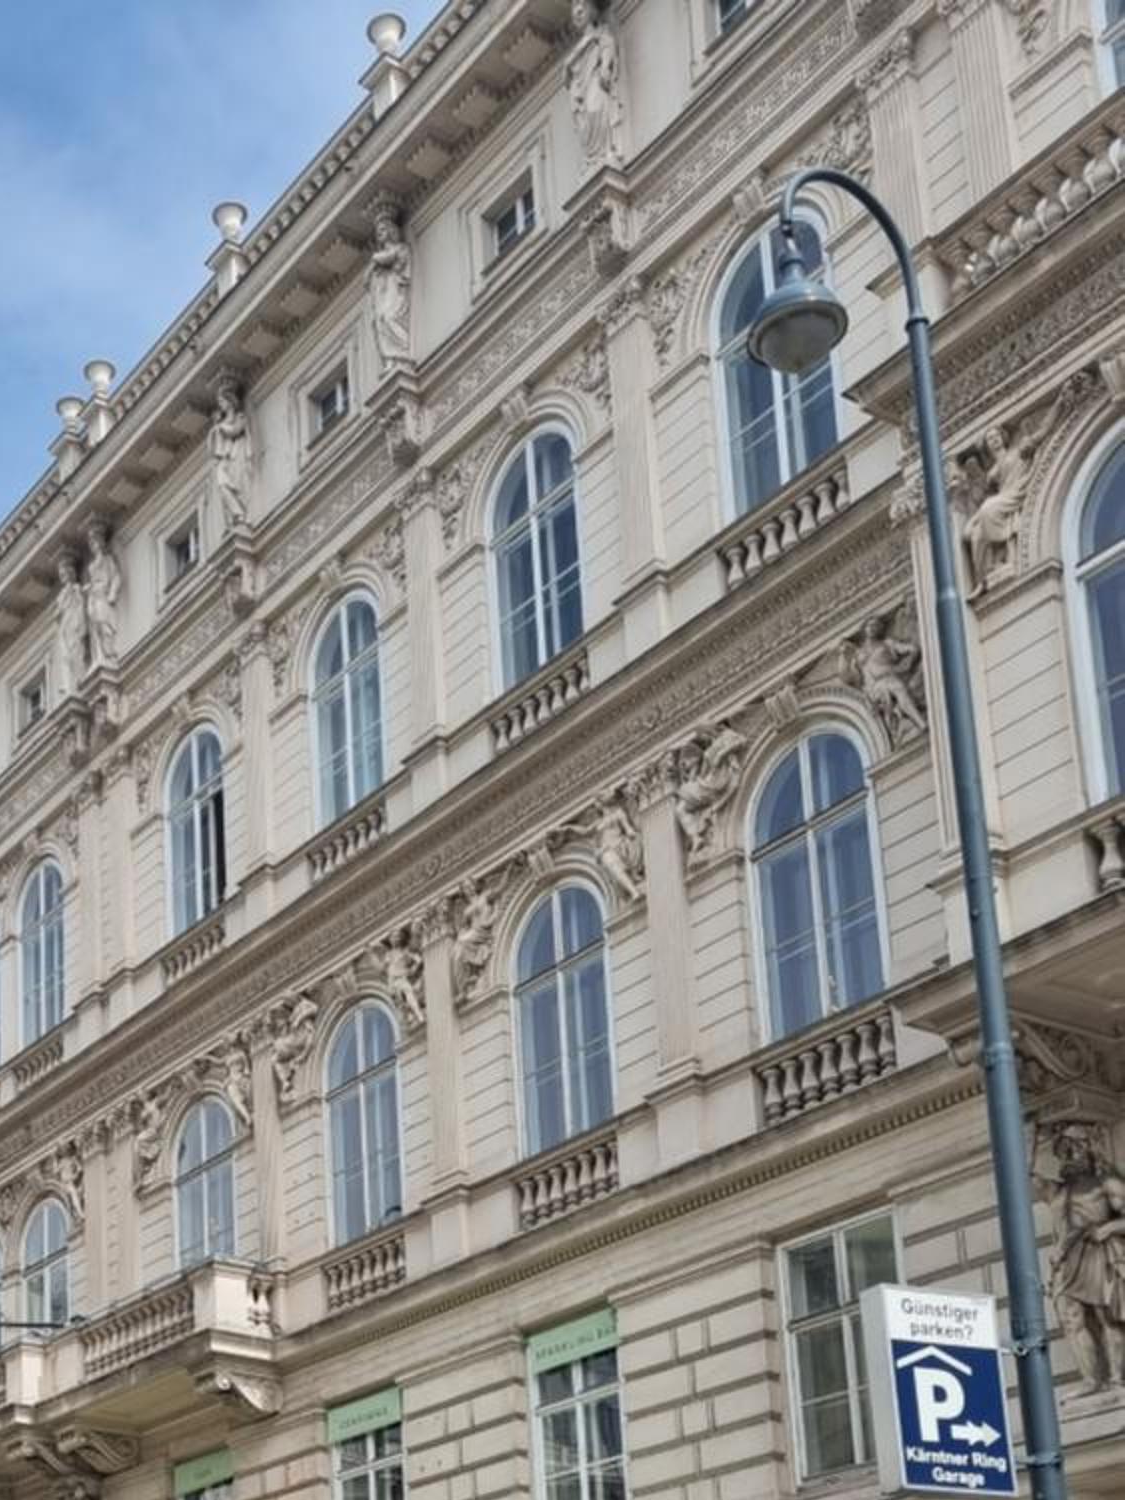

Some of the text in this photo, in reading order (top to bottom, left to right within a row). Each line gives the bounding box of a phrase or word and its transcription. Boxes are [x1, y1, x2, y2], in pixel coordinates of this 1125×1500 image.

[901, 1298, 979, 1324] Günstiger
[910, 1322, 974, 1341] parken?
[913, 1367, 965, 1442] P
[906, 1446, 1007, 1473] Kärntner Ring
[932, 1467, 985, 1488] Garage
